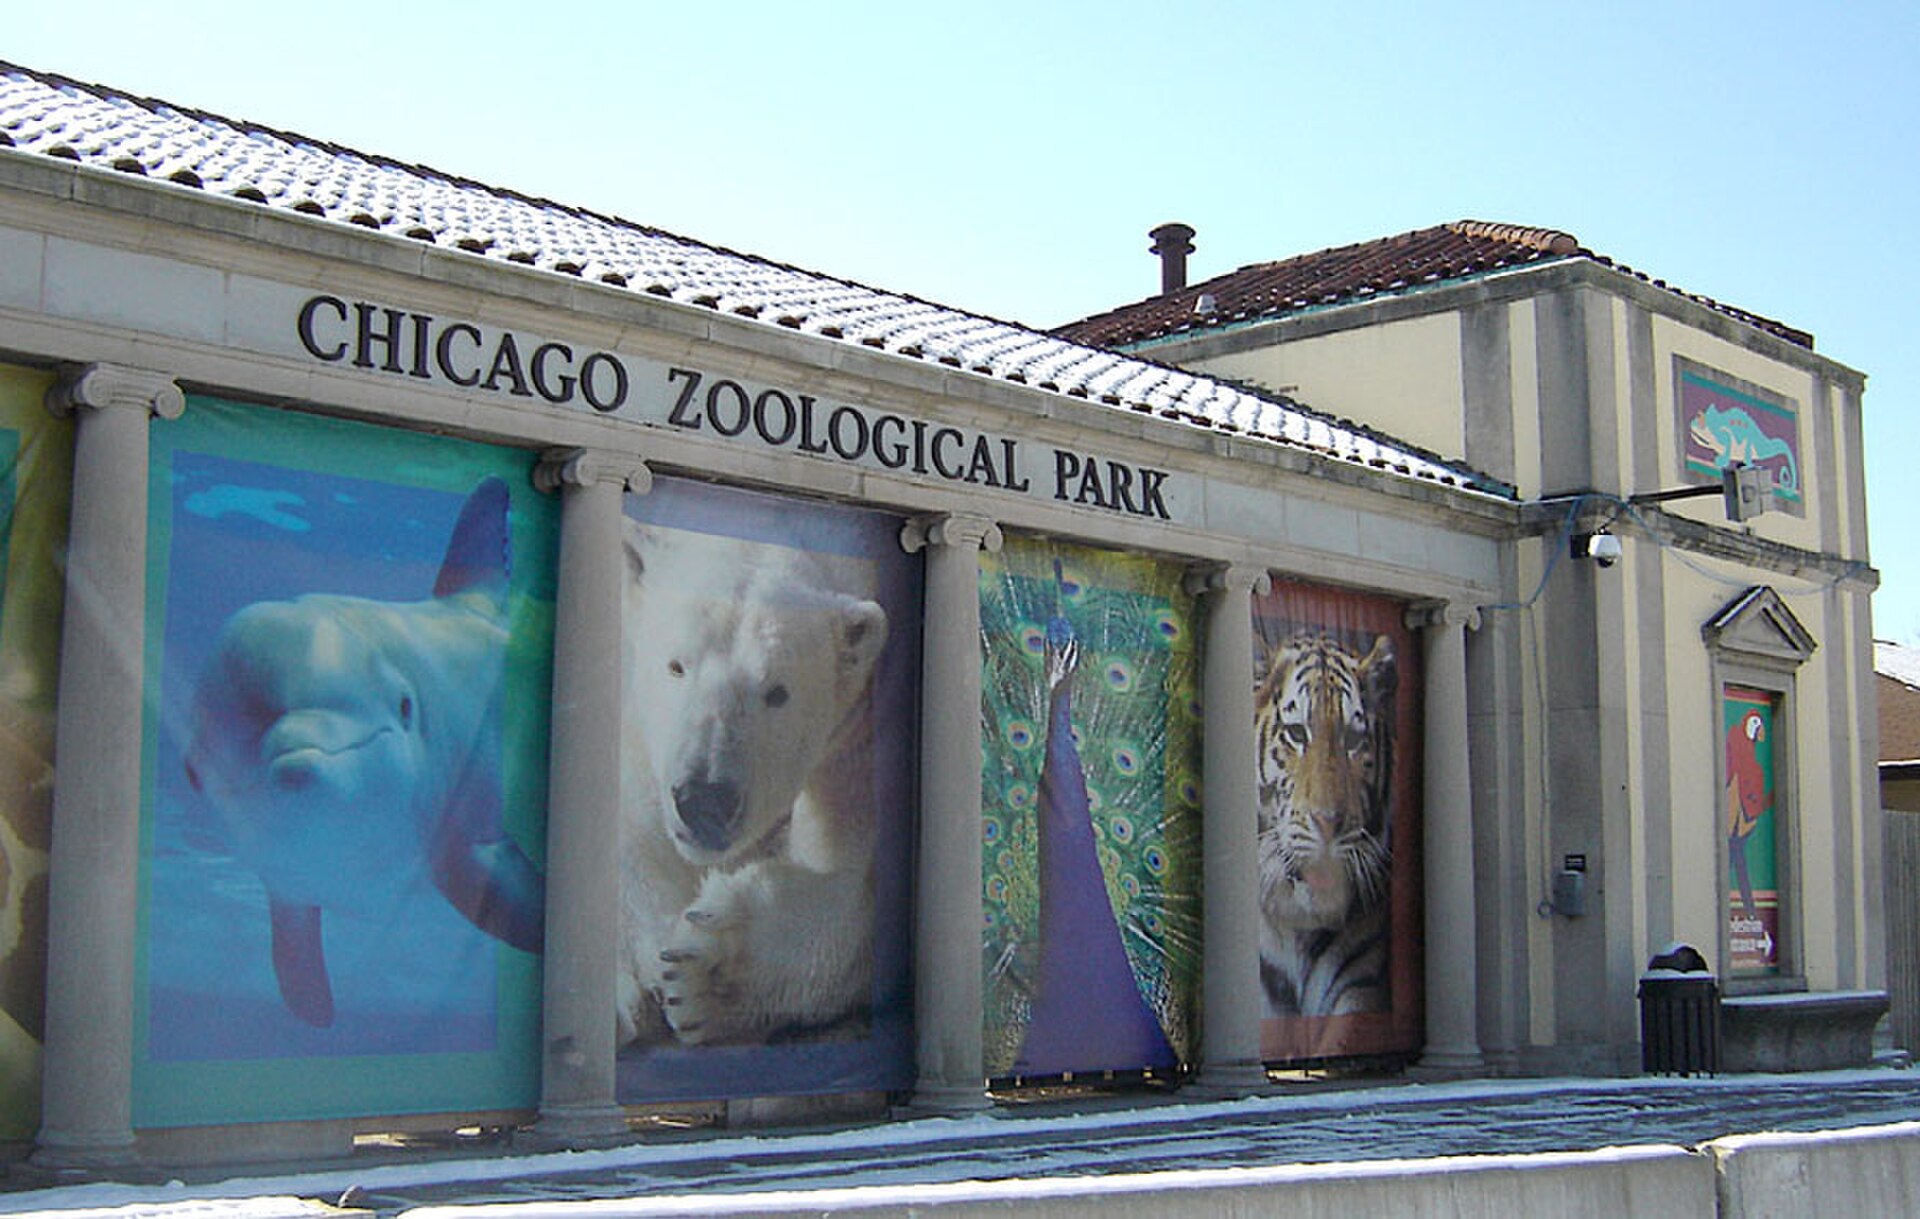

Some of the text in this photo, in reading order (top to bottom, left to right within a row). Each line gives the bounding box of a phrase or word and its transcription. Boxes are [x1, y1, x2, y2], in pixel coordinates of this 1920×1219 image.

[299, 296, 1171, 519] CHICAGO ZOOLOGICAL PARK
